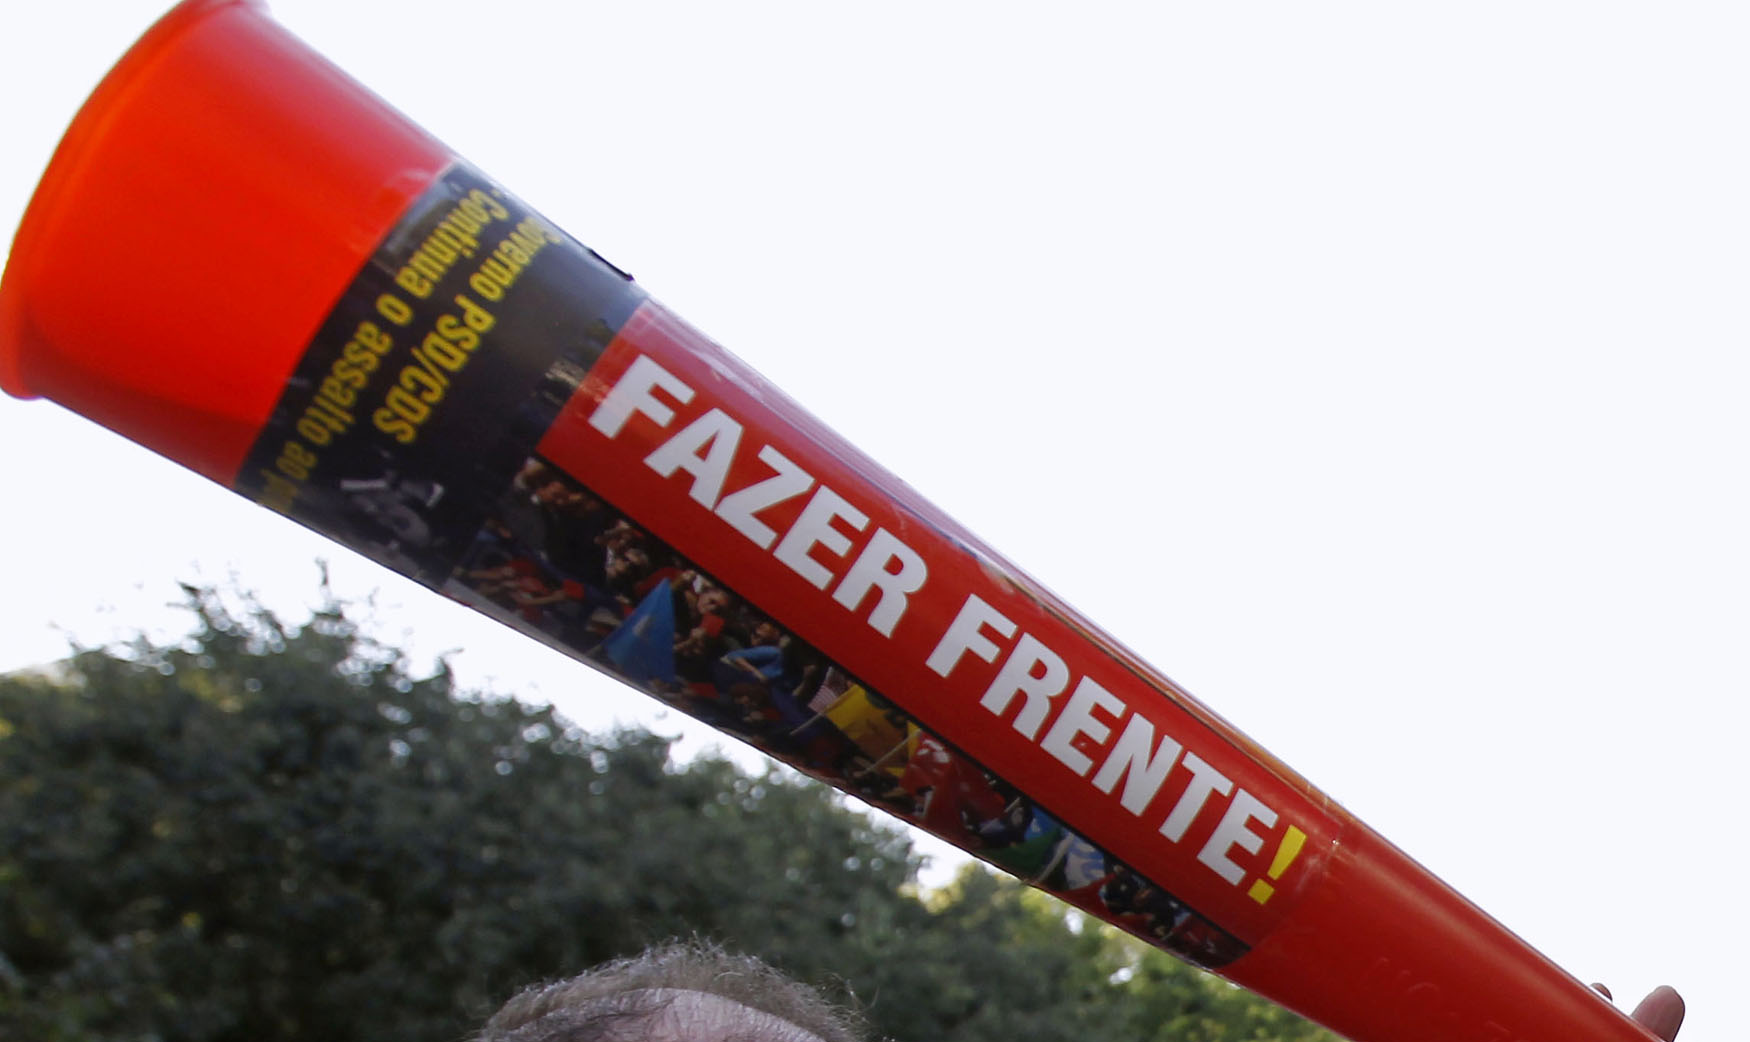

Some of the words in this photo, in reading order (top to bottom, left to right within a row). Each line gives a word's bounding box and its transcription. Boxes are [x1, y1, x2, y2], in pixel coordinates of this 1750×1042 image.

[395, 187, 510, 298] Continua
[469, 216, 562, 303] Governo
[376, 293, 414, 326] o
[297, 320, 393, 446] assalto
[373, 294, 497, 443] PSD/CDS
[275, 441, 318, 482] ao
[588, 353, 928, 639] FAZER
[925, 593, 1307, 905] FRENTE!
